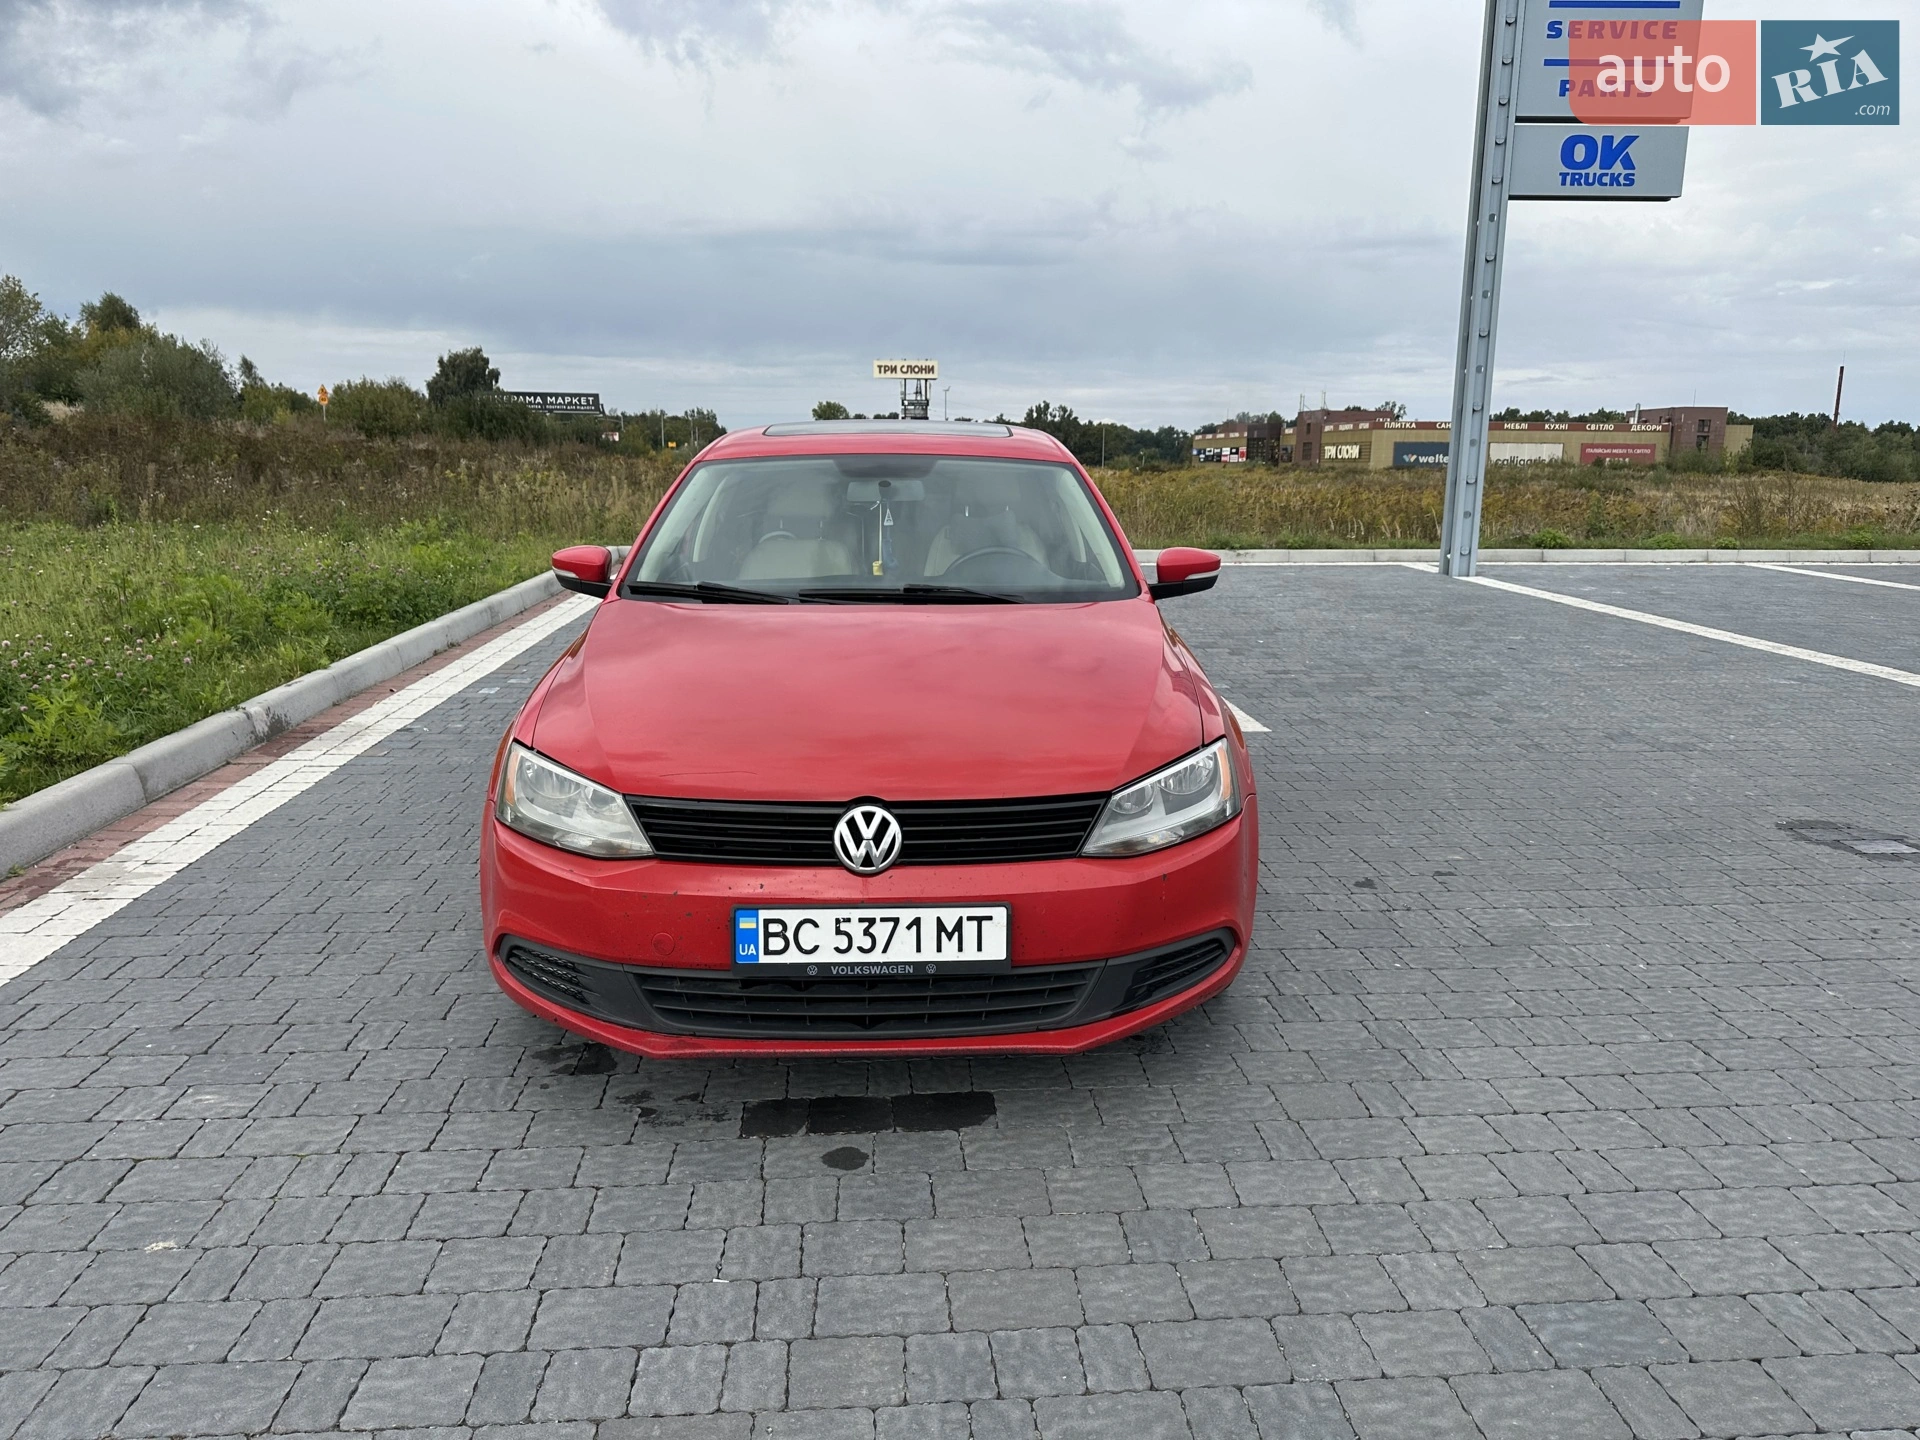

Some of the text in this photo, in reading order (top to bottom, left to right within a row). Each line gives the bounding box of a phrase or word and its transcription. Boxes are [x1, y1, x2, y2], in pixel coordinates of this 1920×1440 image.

[1546, 20, 1678, 40] SERVICE
[1558, 79, 1653, 98] PARTS
[1560, 134, 1640, 171] OK
[1559, 172, 1635, 187] TRUCKS
[877, 365, 935, 375] ТРИ СЛОНИ
[547, 396, 594, 405] МАРКЕТ
[1324, 445, 1360, 459] ТРИ СЛОНИ
[763, 915, 993, 956] BC 5371 MT
[739, 943, 757, 956] UA
[830, 964, 914, 975] VOLKSWAGEN
